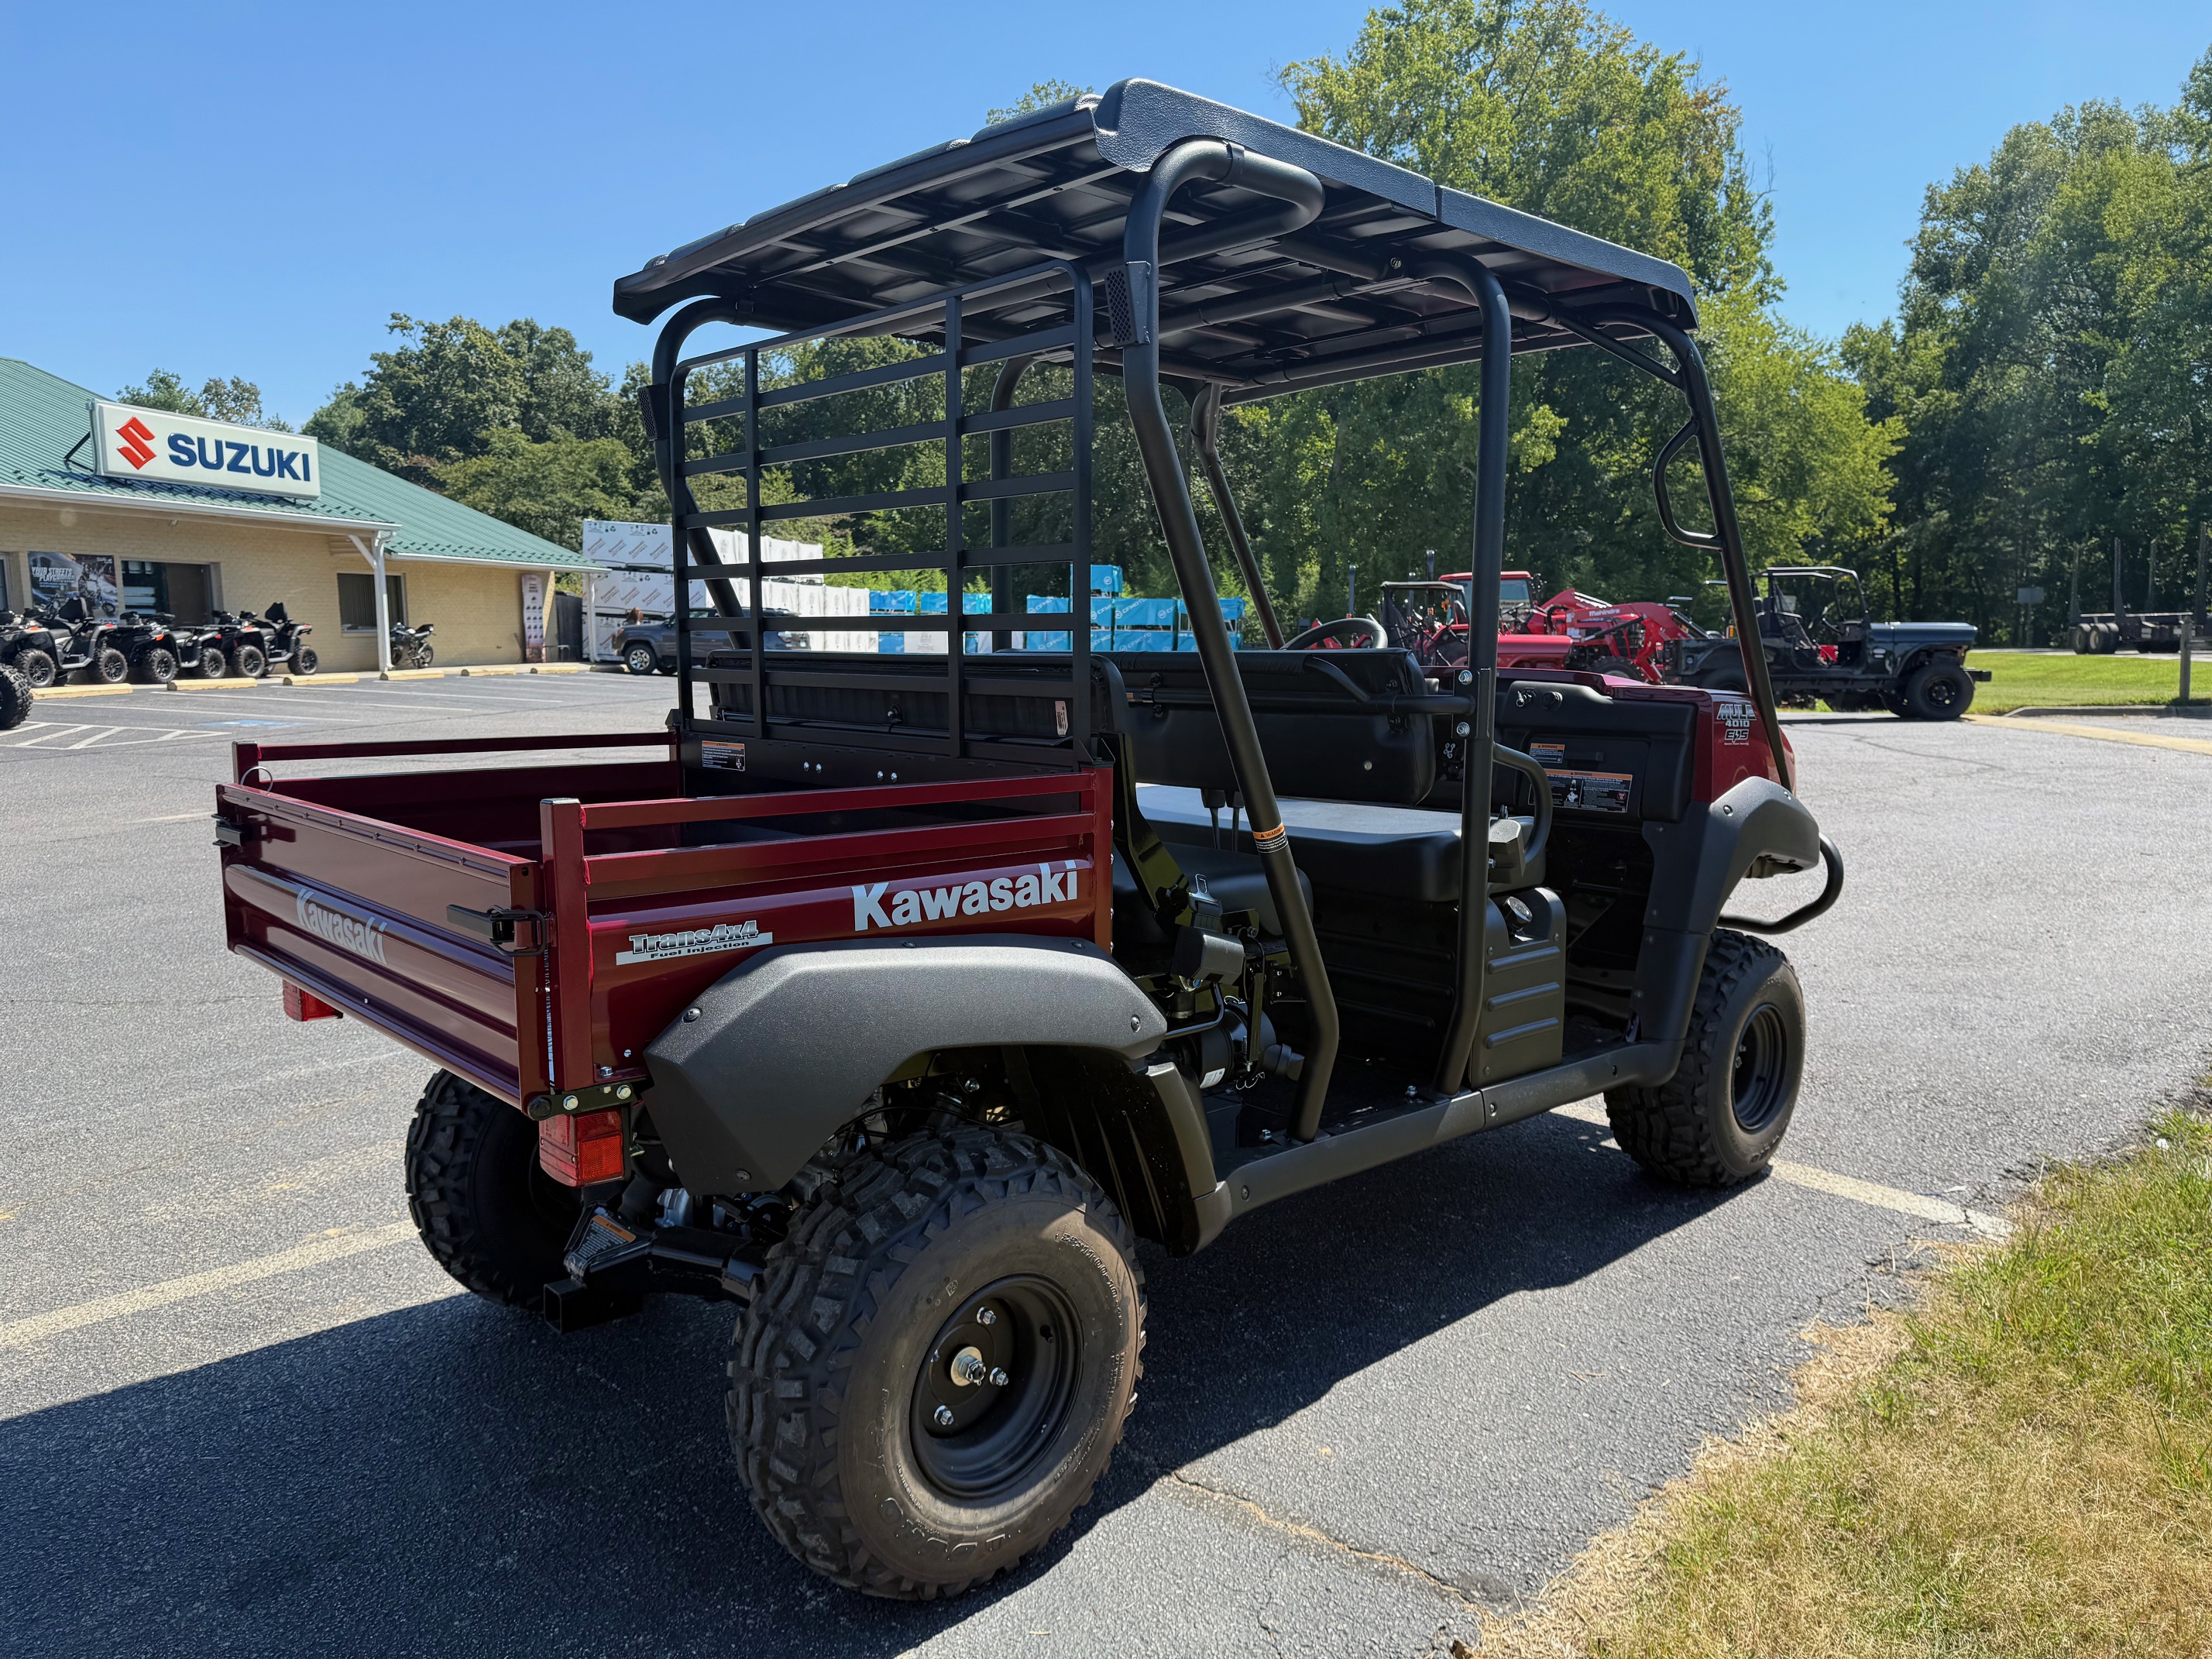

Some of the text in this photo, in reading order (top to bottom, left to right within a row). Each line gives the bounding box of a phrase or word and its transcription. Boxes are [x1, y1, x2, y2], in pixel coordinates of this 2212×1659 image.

[167, 433, 311, 482] SUZUKI
[1716, 703, 1757, 720] MULE
[1725, 729, 1750, 744] EPS
[851, 860, 1077, 932] Kawasaki
[296, 888, 388, 965] Kawasaki
[629, 919, 759, 954] Trans4x4
[650, 940, 750, 959] Fuel Injection
